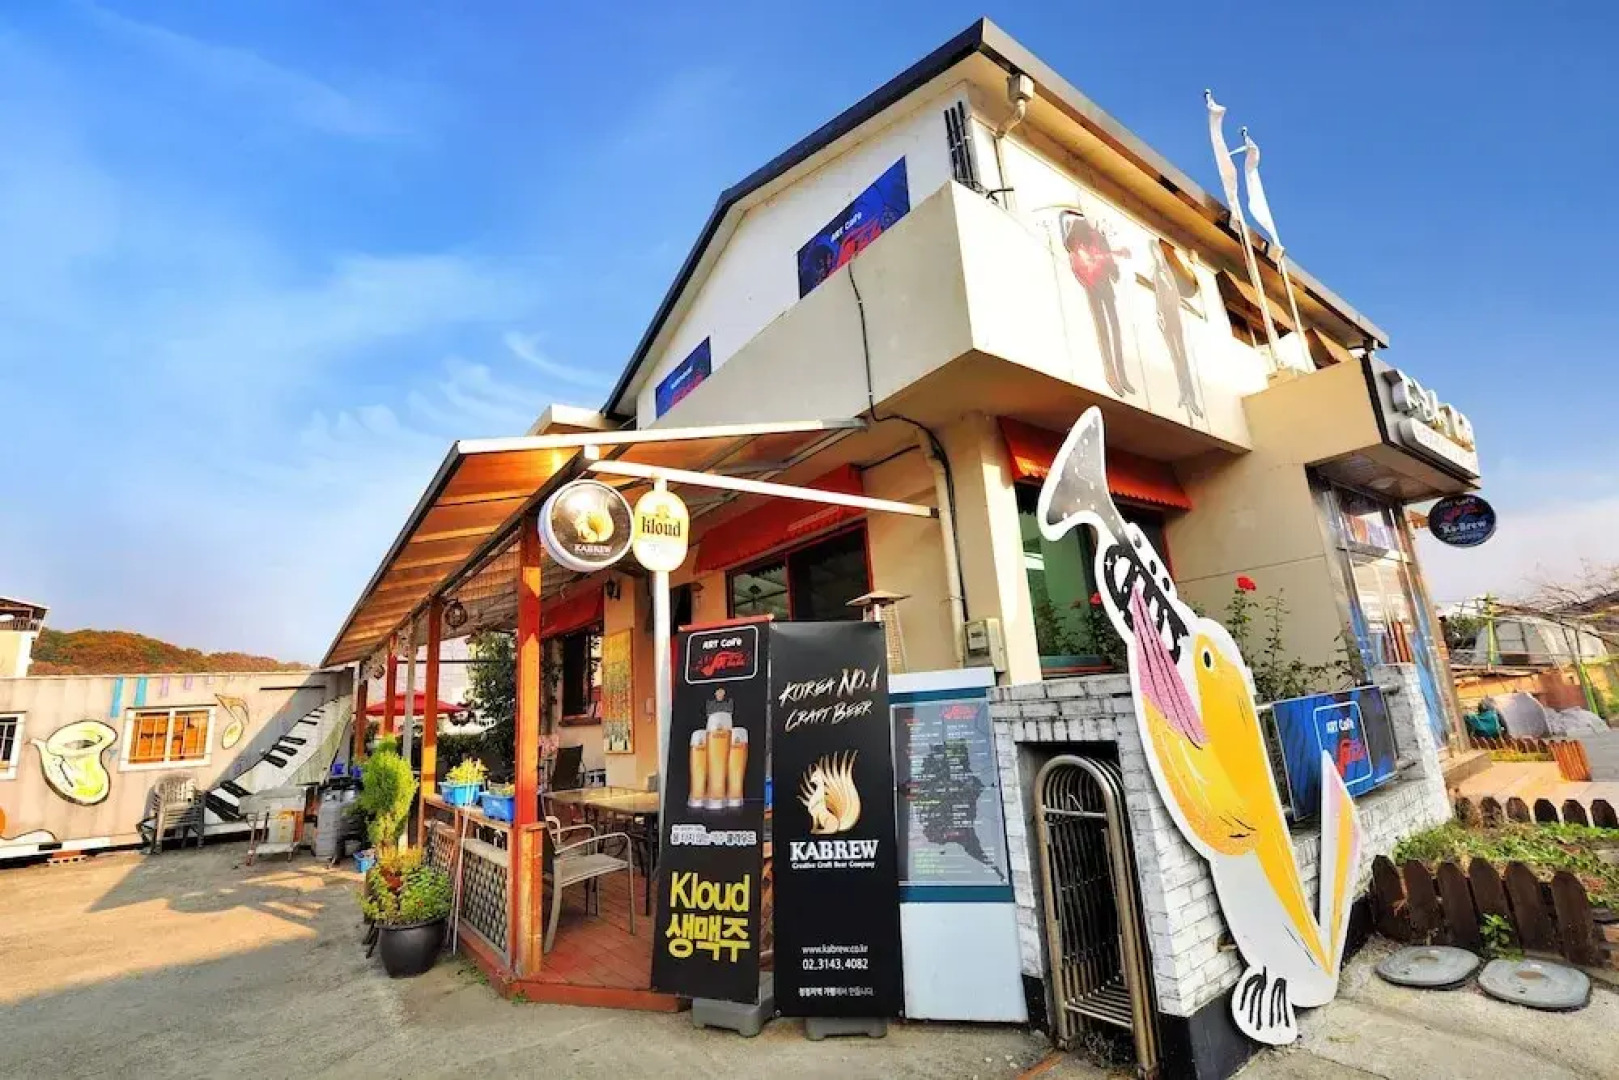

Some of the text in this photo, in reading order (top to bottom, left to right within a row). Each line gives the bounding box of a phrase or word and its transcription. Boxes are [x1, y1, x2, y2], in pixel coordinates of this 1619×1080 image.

[778, 677, 836, 708] KOREA
[784, 700, 873, 733] CRAFT BEER
[789, 839, 879, 861] KABREW
[669, 871, 750, 913] Kloud
[665, 913, 750, 963] 생맥주
